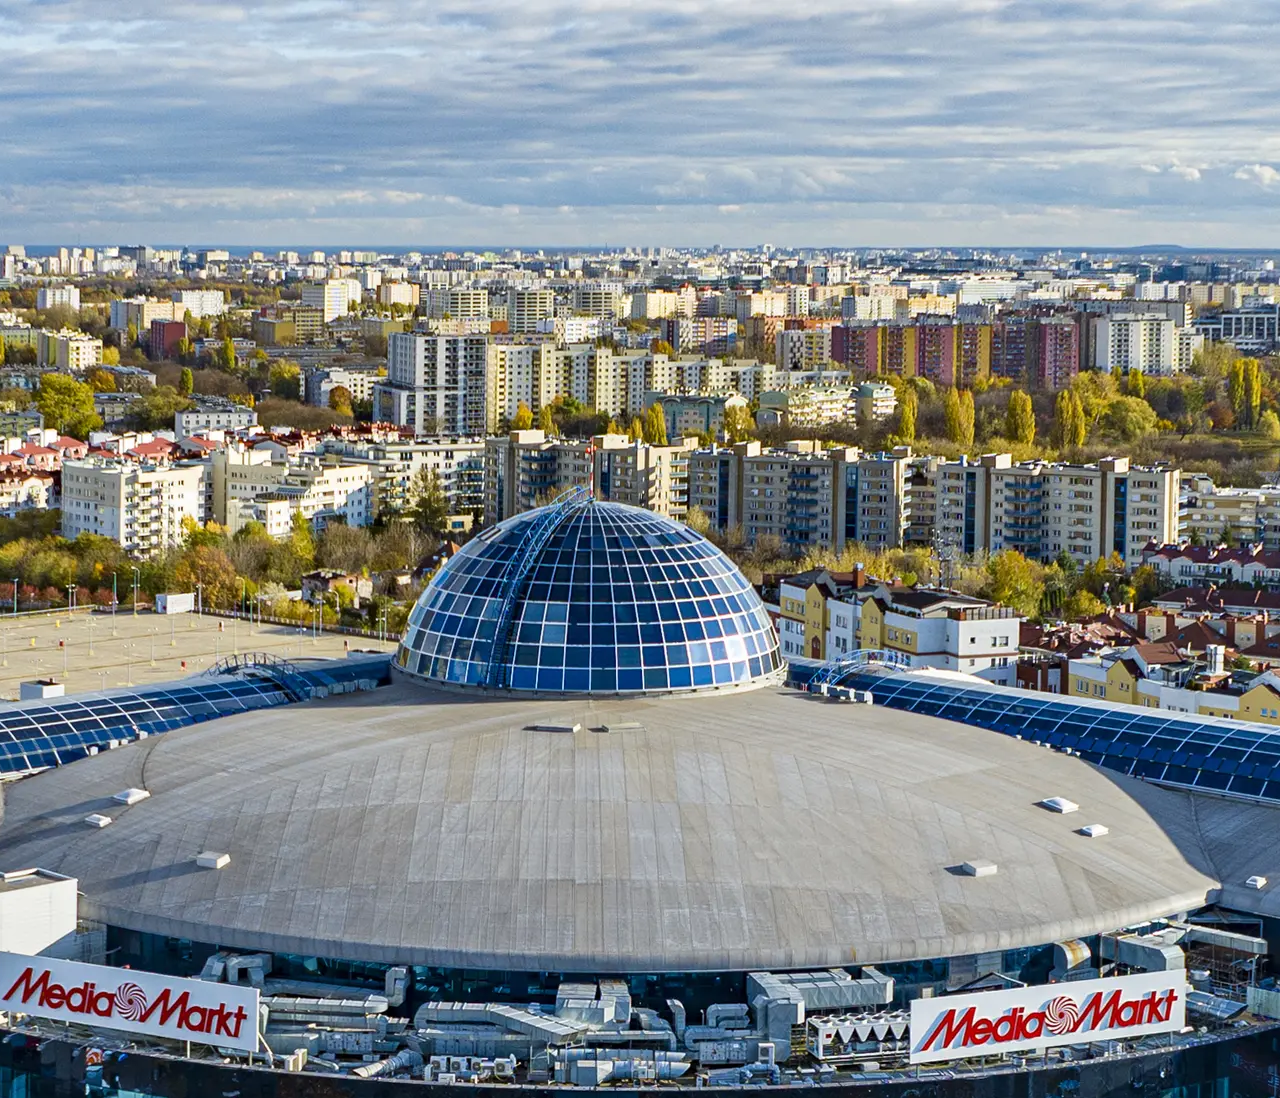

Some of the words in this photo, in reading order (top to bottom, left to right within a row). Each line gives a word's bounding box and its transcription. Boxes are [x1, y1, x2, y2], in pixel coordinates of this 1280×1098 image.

[2, 967, 117, 1018] Media
[140, 988, 248, 1038] Markt
[920, 1006, 1046, 1051] Media
[1070, 988, 1179, 1033] Markt
